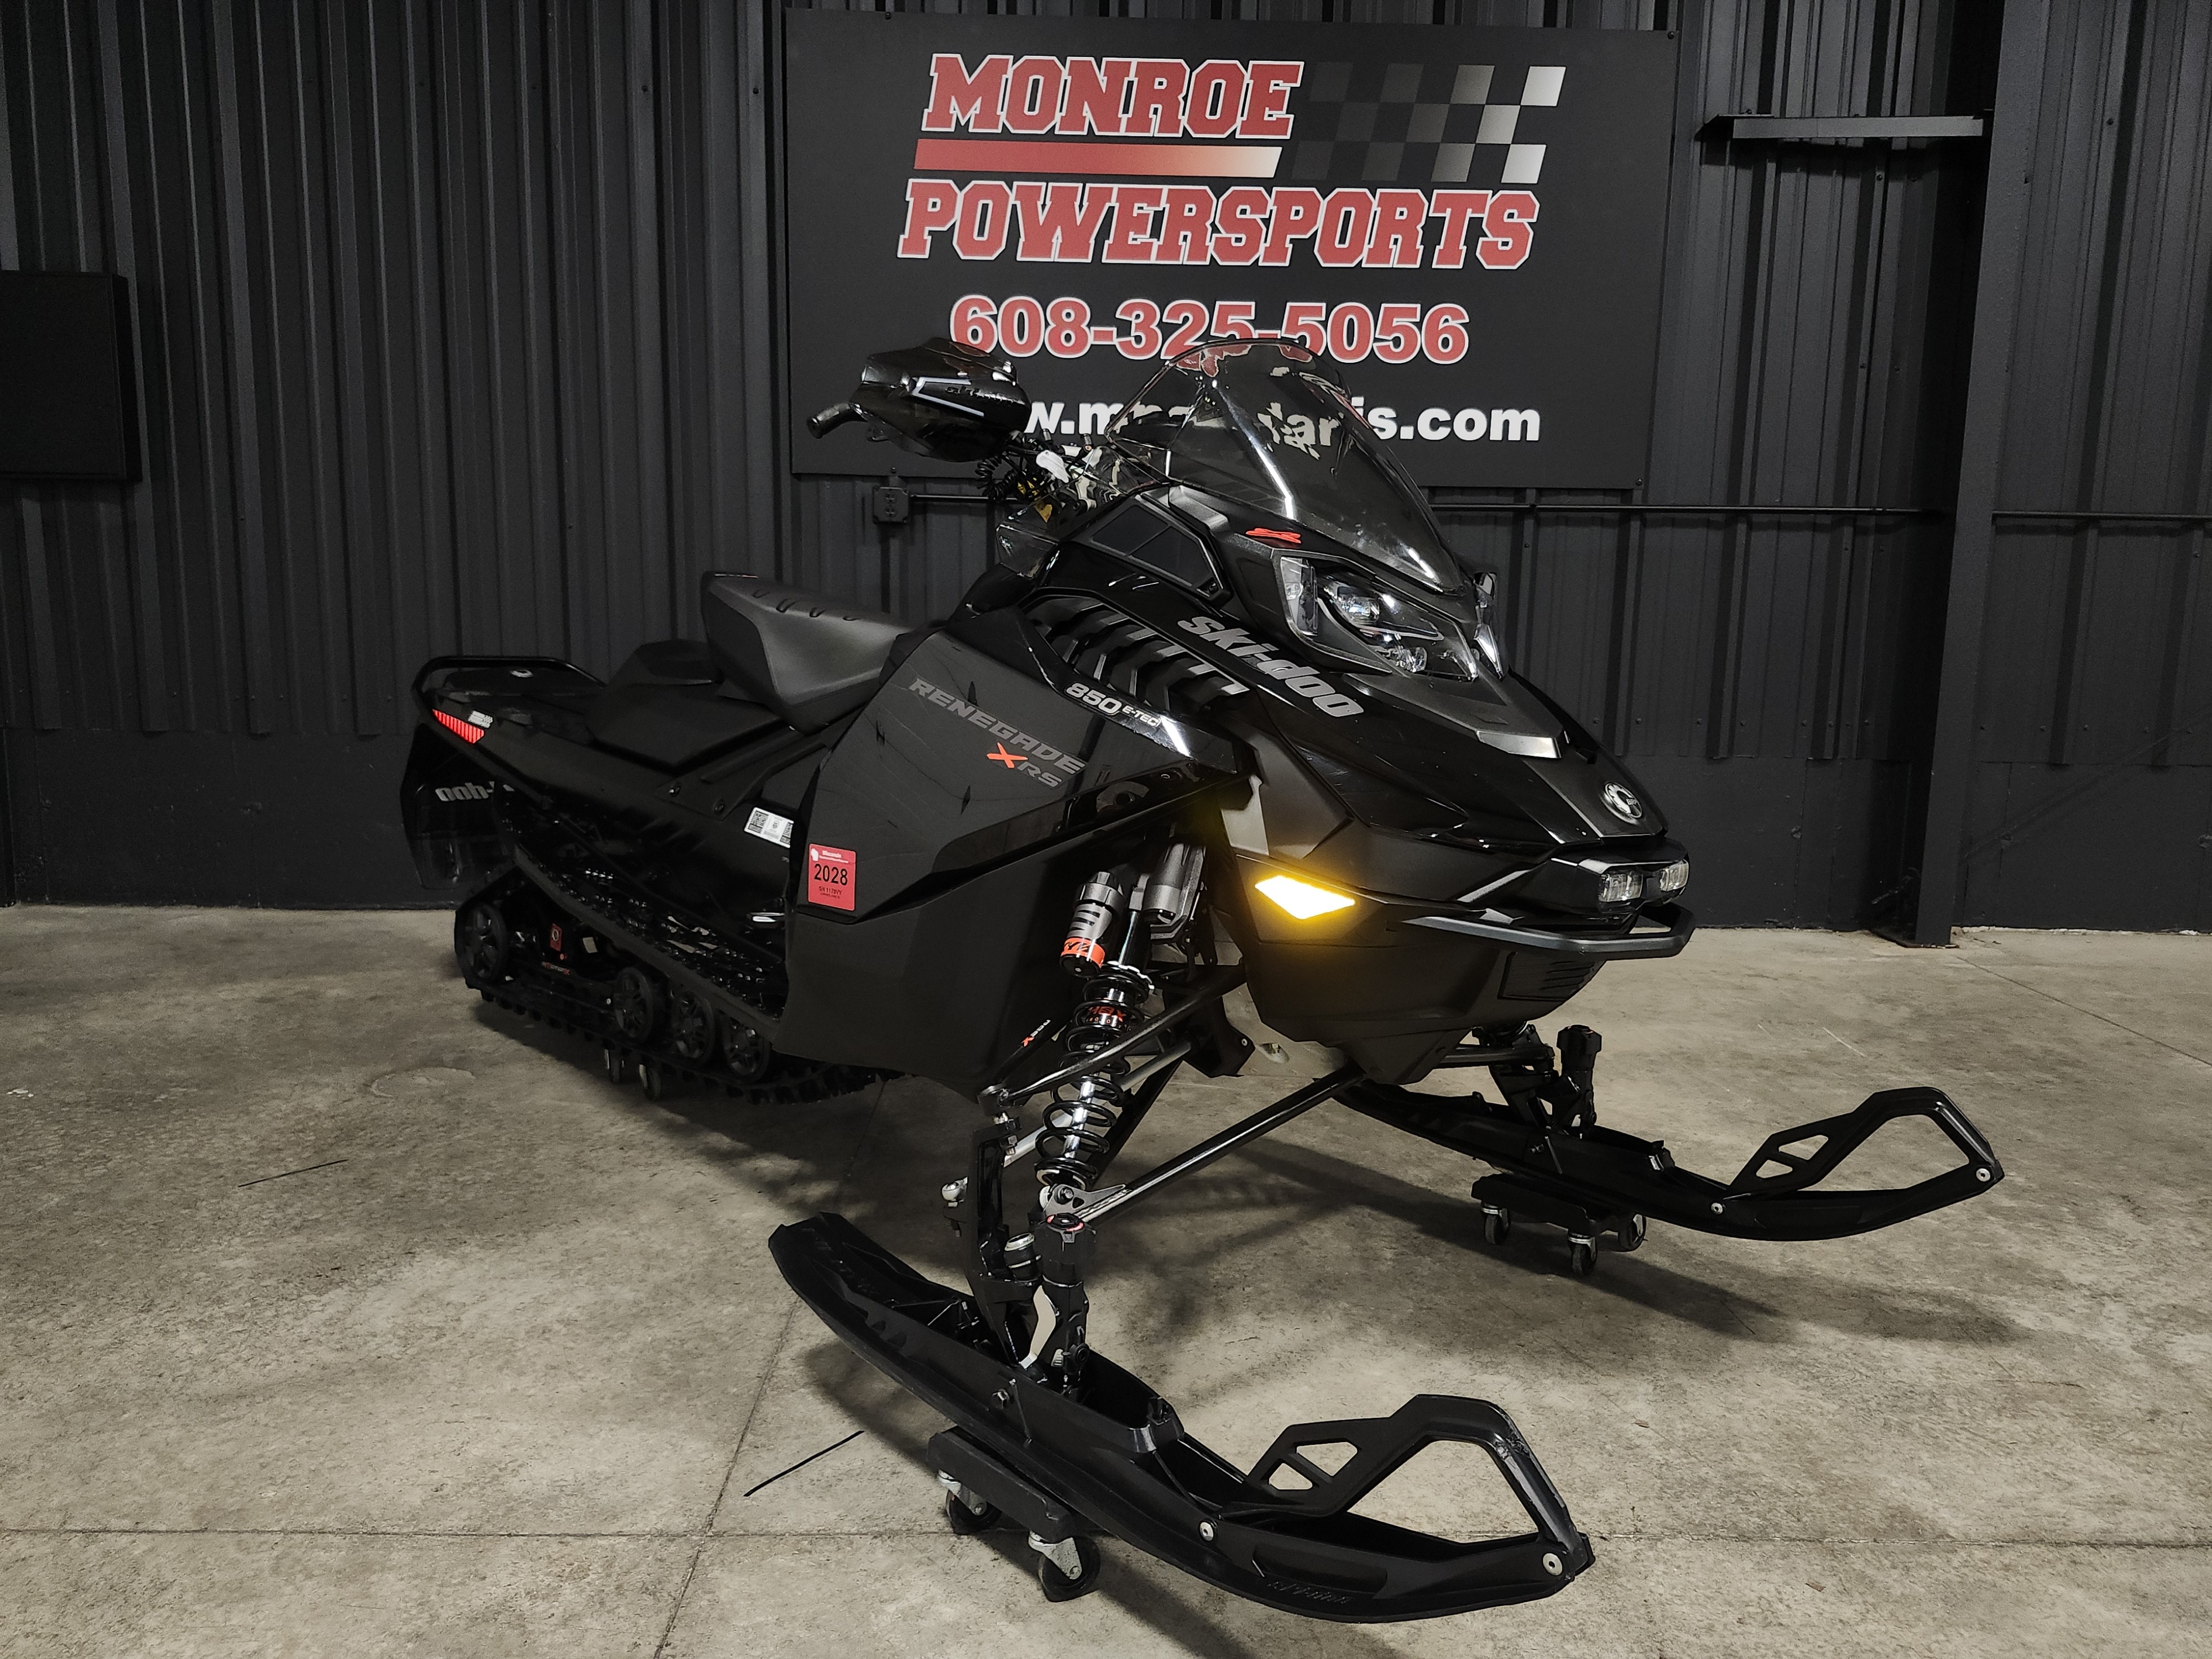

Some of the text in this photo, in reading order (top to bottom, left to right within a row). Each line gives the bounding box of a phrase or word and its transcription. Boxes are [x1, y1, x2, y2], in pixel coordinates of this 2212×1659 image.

[921, 53, 1304, 139] MONROE
[897, 179, 1540, 269] POWERSPORTS
[909, 677, 1086, 774] RENEGADE
[1066, 682, 1160, 727] 850 E-TEC
[814, 863, 848, 886] 2028
